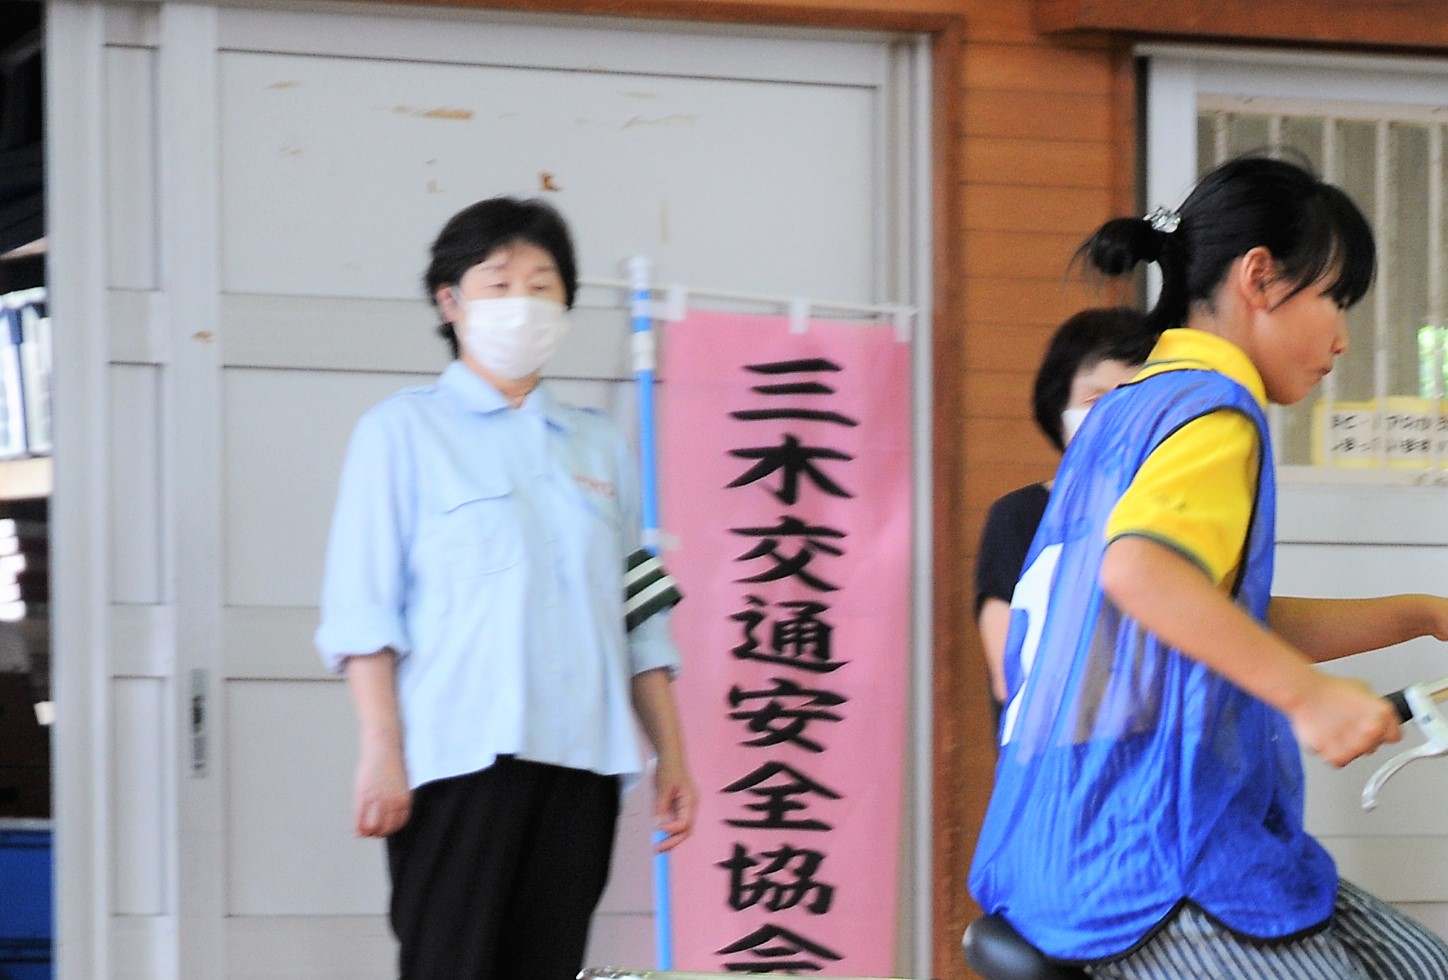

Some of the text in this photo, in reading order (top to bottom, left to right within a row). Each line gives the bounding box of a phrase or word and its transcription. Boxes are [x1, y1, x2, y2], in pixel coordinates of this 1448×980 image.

[715, 357, 860, 975] 三木交通安全協会
